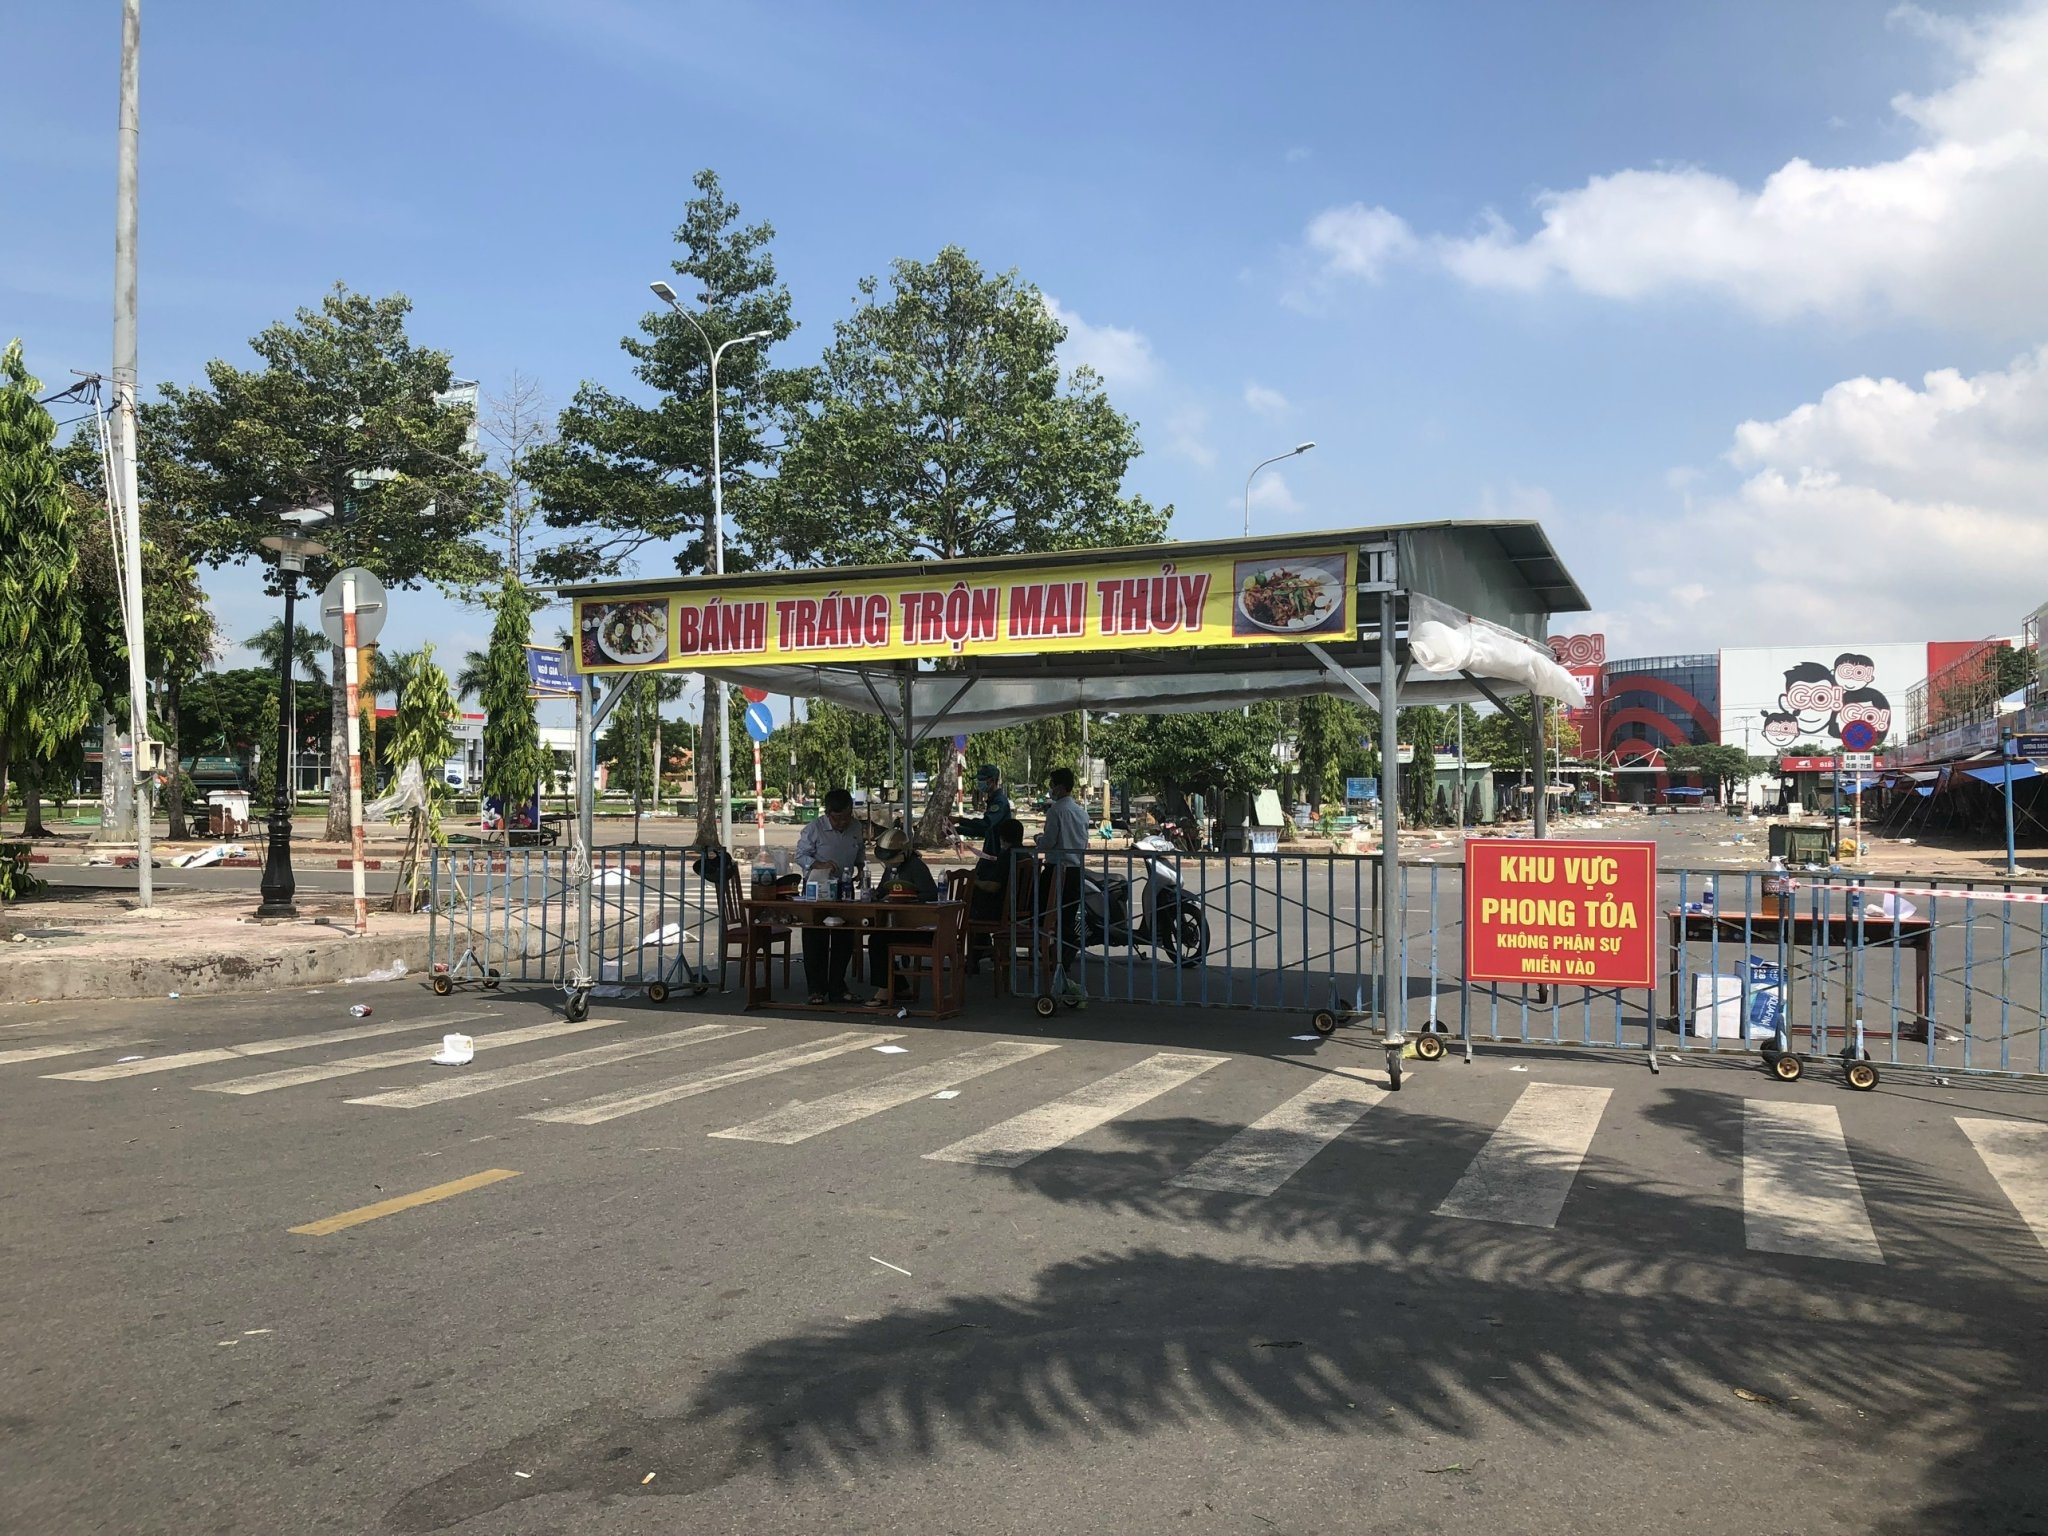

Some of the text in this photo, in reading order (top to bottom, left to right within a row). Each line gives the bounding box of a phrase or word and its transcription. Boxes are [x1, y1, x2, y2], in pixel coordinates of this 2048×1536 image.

[680, 562, 1212, 655] BÁNH TRÁNG TRỘN MAI THỦY
[1546, 633, 1605, 665] GO!
[1837, 662, 1874, 683] GO!
[1787, 684, 1844, 712] GO!
[1766, 720, 1800, 737] GO!
[1841, 703, 1890, 732] GO!
[1500, 855, 1618, 891] KHU VỰC
[1482, 892, 1638, 929] PHONG TỎA
[1497, 932, 1622, 955] KHÔNG PHẬN SỰ
[1521, 954, 1596, 975] MIỄN VÀO
[1758, 969, 1766, 980] 28
